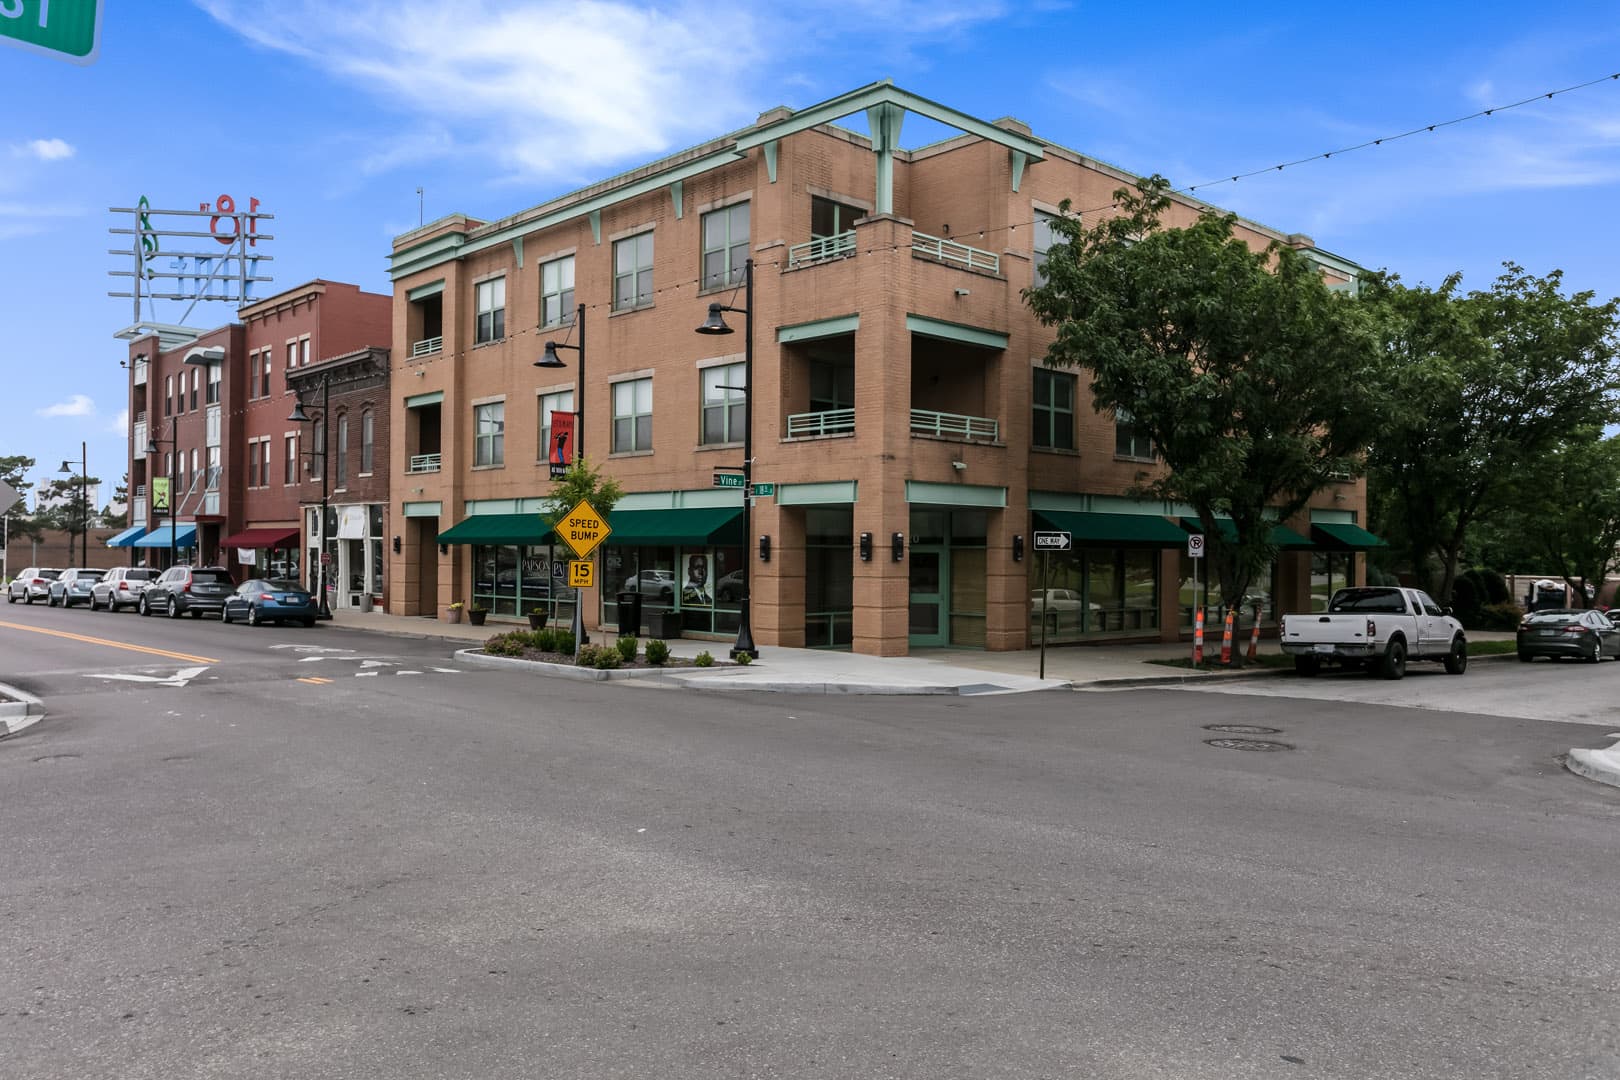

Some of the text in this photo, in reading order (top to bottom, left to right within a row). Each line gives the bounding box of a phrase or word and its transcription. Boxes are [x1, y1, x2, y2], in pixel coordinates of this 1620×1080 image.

[720, 475, 737, 486] Vine
[569, 518, 599, 529] SPEED
[570, 530, 599, 541] BUMP
[1038, 537, 1060, 545] ONE WAY
[574, 564, 590, 577] 15
